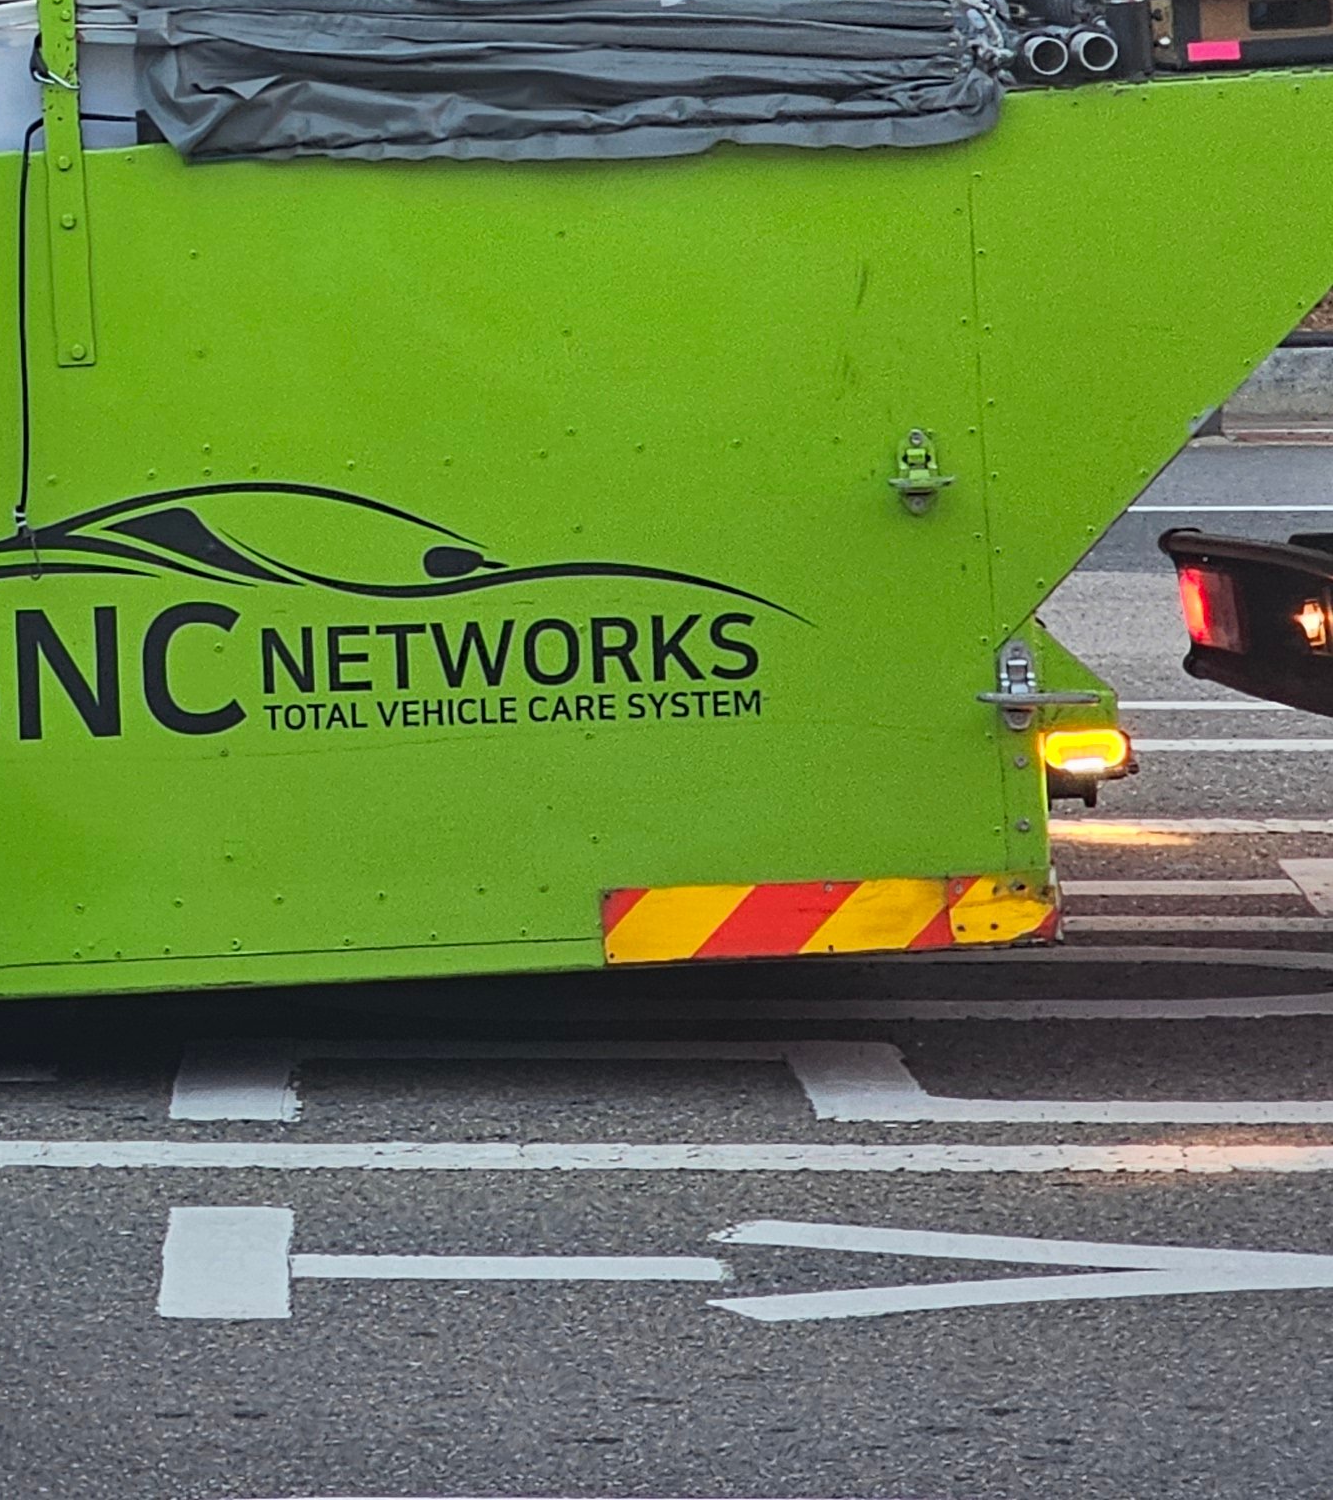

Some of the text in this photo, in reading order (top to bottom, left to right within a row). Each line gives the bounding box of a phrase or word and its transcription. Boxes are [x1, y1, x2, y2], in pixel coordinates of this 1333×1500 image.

[261, 612, 761, 695] NETWORKS
[264, 689, 763, 731] TOTAL VEHICLE CARE SYSTEM
